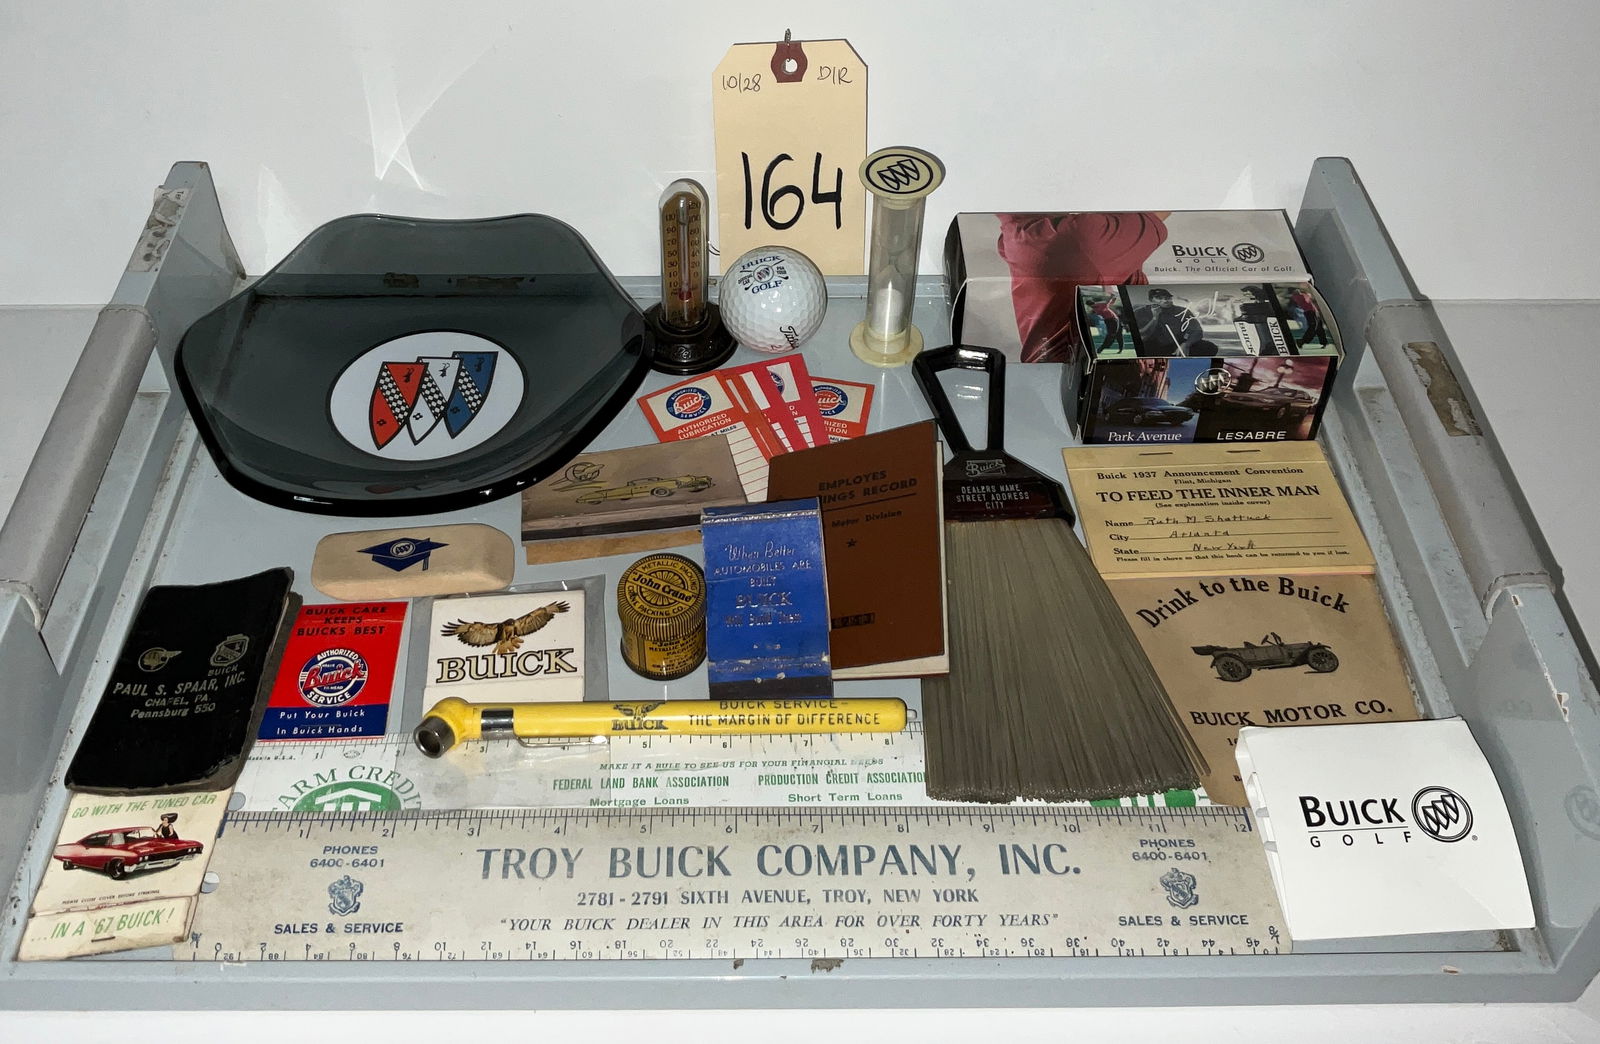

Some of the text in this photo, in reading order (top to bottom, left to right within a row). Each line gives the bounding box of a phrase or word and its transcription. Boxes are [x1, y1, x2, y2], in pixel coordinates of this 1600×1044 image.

[722, 73, 761, 93] 10/28
[741, 152, 843, 230] 164
[1171, 244, 1228, 257] BUICK
[741, 255, 781, 270] BUICK
[751, 280, 783, 294] GOLF
[1269, 321, 1288, 356] BUICK
[673, 391, 707, 415] Buick
[677, 413, 727, 434] AUTHORIZED
[678, 417, 732, 440] LUBRICATION
[720, 425, 737, 434] MILES
[1108, 431, 1182, 442] Park Avenue
[965, 459, 1007, 477] Buick
[1096, 466, 1304, 480] Buick 1937 Announcement Convention
[818, 470, 888, 491] EMPLOYES
[821, 478, 918, 504] INGS RECORD
[961, 484, 1020, 494] DEALERS NAME
[1096, 485, 1320, 502] TO FEED THE INNER MAN
[955, 491, 1030, 503] STREET ADDRESS
[985, 501, 1005, 510] CITY
[865, 510, 903, 522] Division
[1109, 533, 1130, 542] City
[1113, 547, 1140, 555] State
[641, 558, 678, 571] METALLIC
[713, 560, 812, 576] AUTOMOBILES ARE
[750, 576, 777, 588] BUILT
[735, 591, 793, 609] BUICK
[1136, 576, 1351, 628] Drink to the Buick
[305, 605, 388, 615] BUICK CARE
[638, 605, 686, 617] PACKING CO.
[323, 616, 363, 625] KEEPS
[297, 625, 385, 637] BUICKS BEST
[317, 648, 359, 661] AUTHORIZED
[207, 664, 239, 677] BUICK
[436, 647, 578, 684] BUICK
[302, 661, 365, 691] Buick
[112, 671, 246, 697] PAUL S. SPAAR, INC.
[194, 694, 212, 703] PA.
[307, 691, 351, 704] SERVICE
[130, 702, 216, 719] Pennsburg 550
[719, 700, 767, 710] BUICK
[279, 709, 365, 721] Put Your Buick
[688, 712, 880, 727] THE MARGIN OF DIFFERENCE
[1189, 699, 1394, 727] BUICK MOTOR CO.
[276, 725, 363, 735] In Buick Hands
[611, 719, 669, 731] BUICK
[722, 761, 736, 769] US
[552, 775, 729, 791] FEDERAL LAND BANK ASSOCIATION
[758, 771, 926, 786] PRODUCTION CREDIT ASSOCIATIO
[275, 765, 422, 811] ARM CREDIT
[589, 797, 690, 808] Mortgage Loans
[788, 792, 903, 802] Short Term Loans
[71, 794, 218, 819] GO WITH THE TUNED CAR
[1298, 795, 1407, 828] BUICK
[1139, 838, 1196, 848] PHONES
[1309, 830, 1414, 848] GOLF
[322, 845, 378, 855] PHONES
[476, 843, 1082, 882] TROY BUICK COMPANY, INC.
[577, 888, 979, 906] 2781 2791 SIXTH AVENUE, TROY, NEW YORK
[72, 920, 85, 937] A
[94, 916, 115, 935] '67
[563, 917, 615, 931] BUICK
[626, 917, 691, 930] DEALER
[702, 916, 722, 929] IN
[733, 915, 771, 928] THIS
[778, 915, 824, 928] AREA
[835, 914, 866, 928] FOR
[876, 914, 921, 927] OVER
[932, 914, 988, 927] FORTY
[1118, 914, 1249, 926] SALES & SERVICE
[274, 922, 404, 935] SALES & SERVICE
